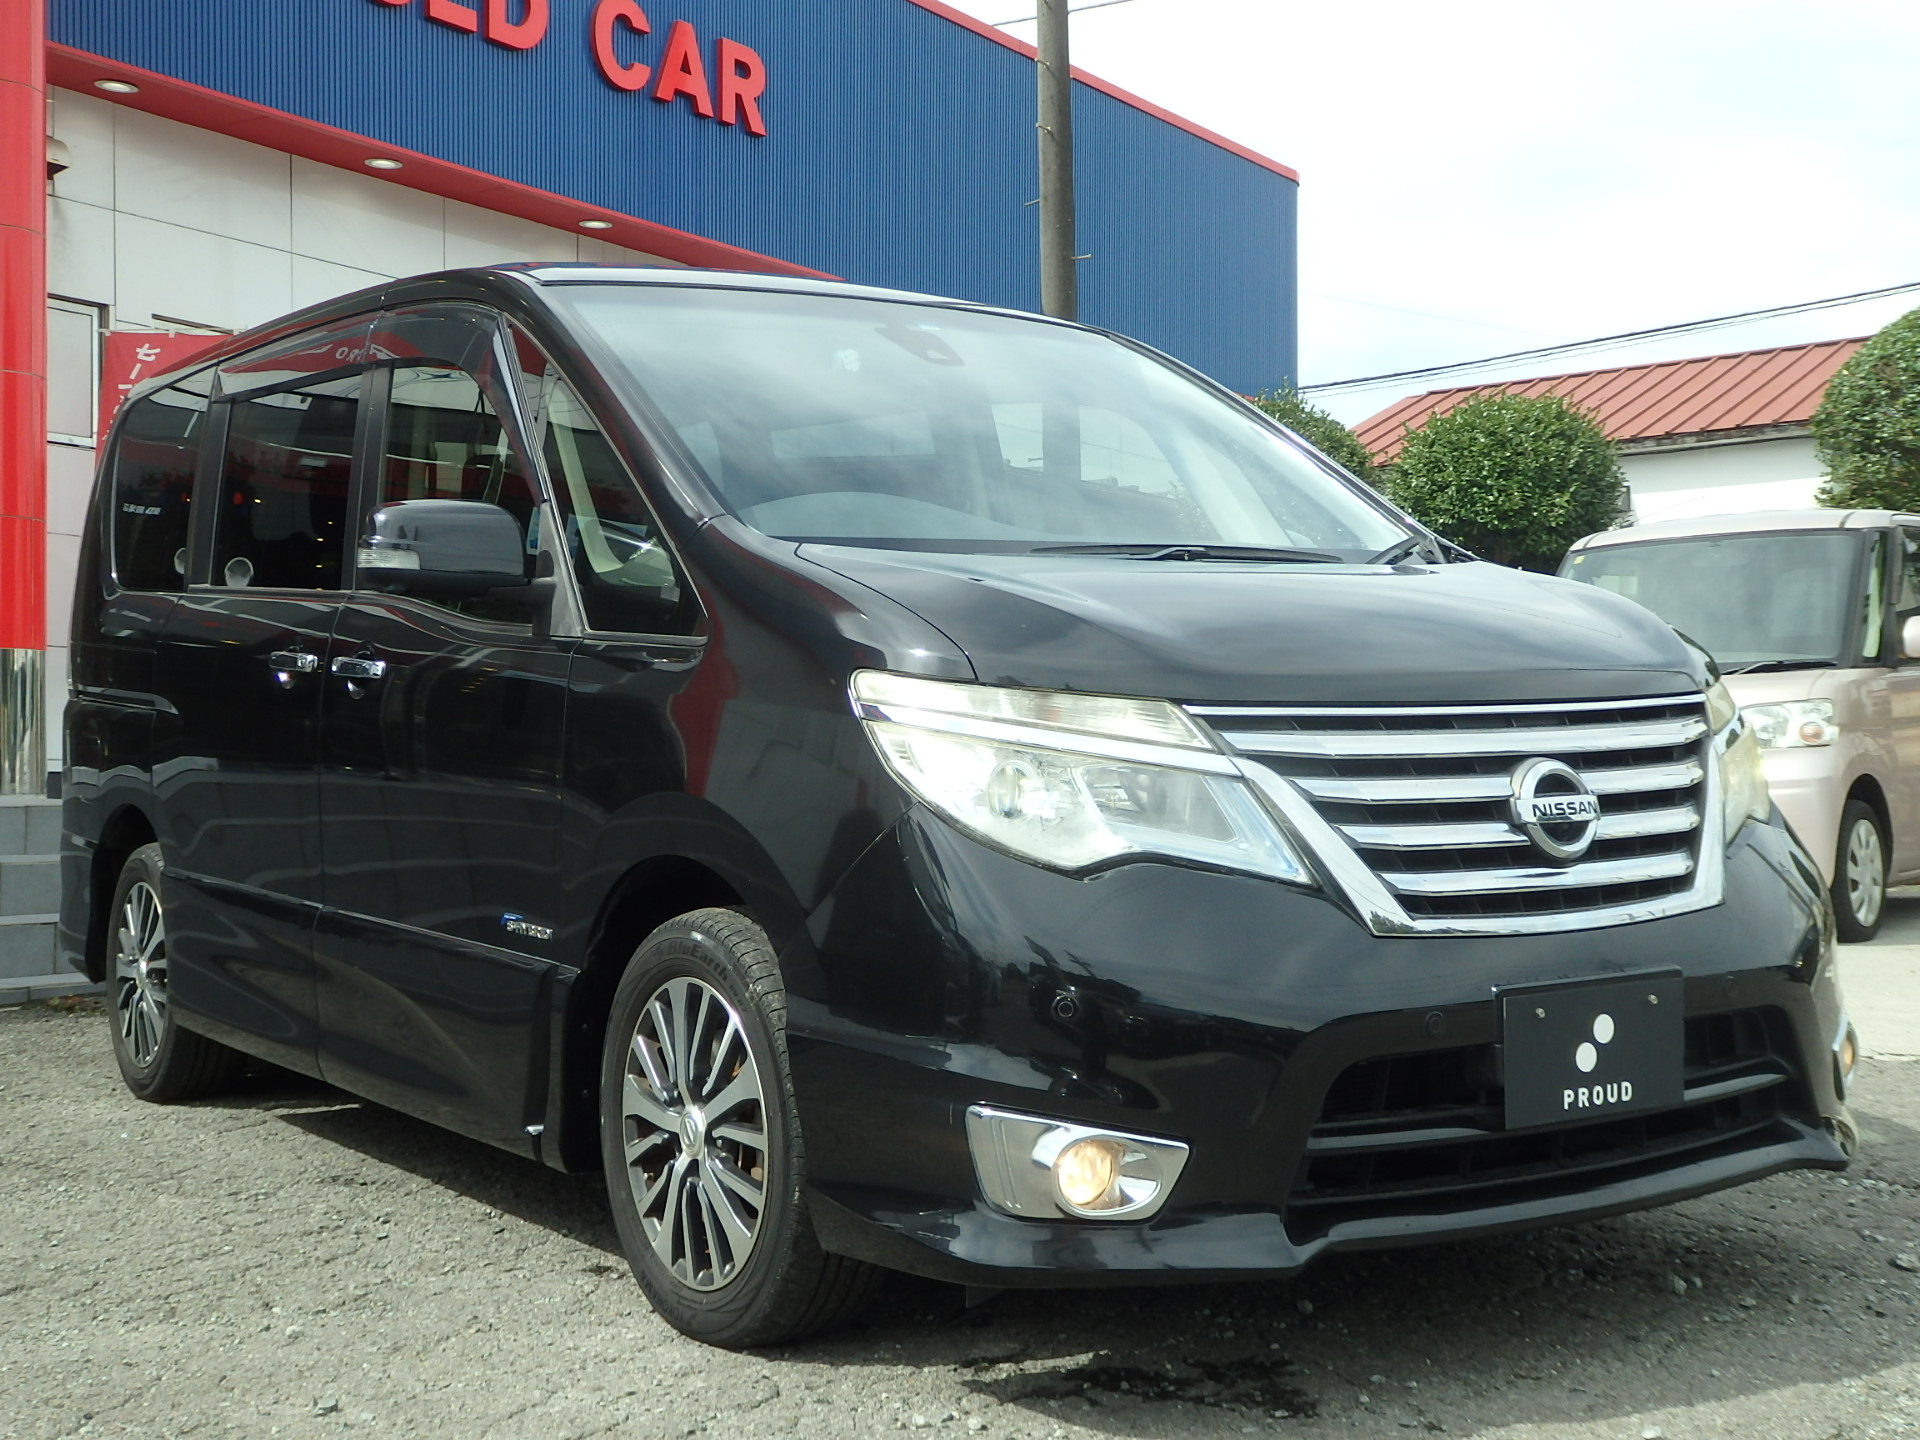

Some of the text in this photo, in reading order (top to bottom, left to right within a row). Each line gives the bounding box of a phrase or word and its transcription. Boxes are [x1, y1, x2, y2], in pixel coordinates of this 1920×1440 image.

[591, 0, 767, 137] CAR
[1532, 801, 1599, 818] NISSAN
[1563, 1081, 1633, 1110] PROUD
